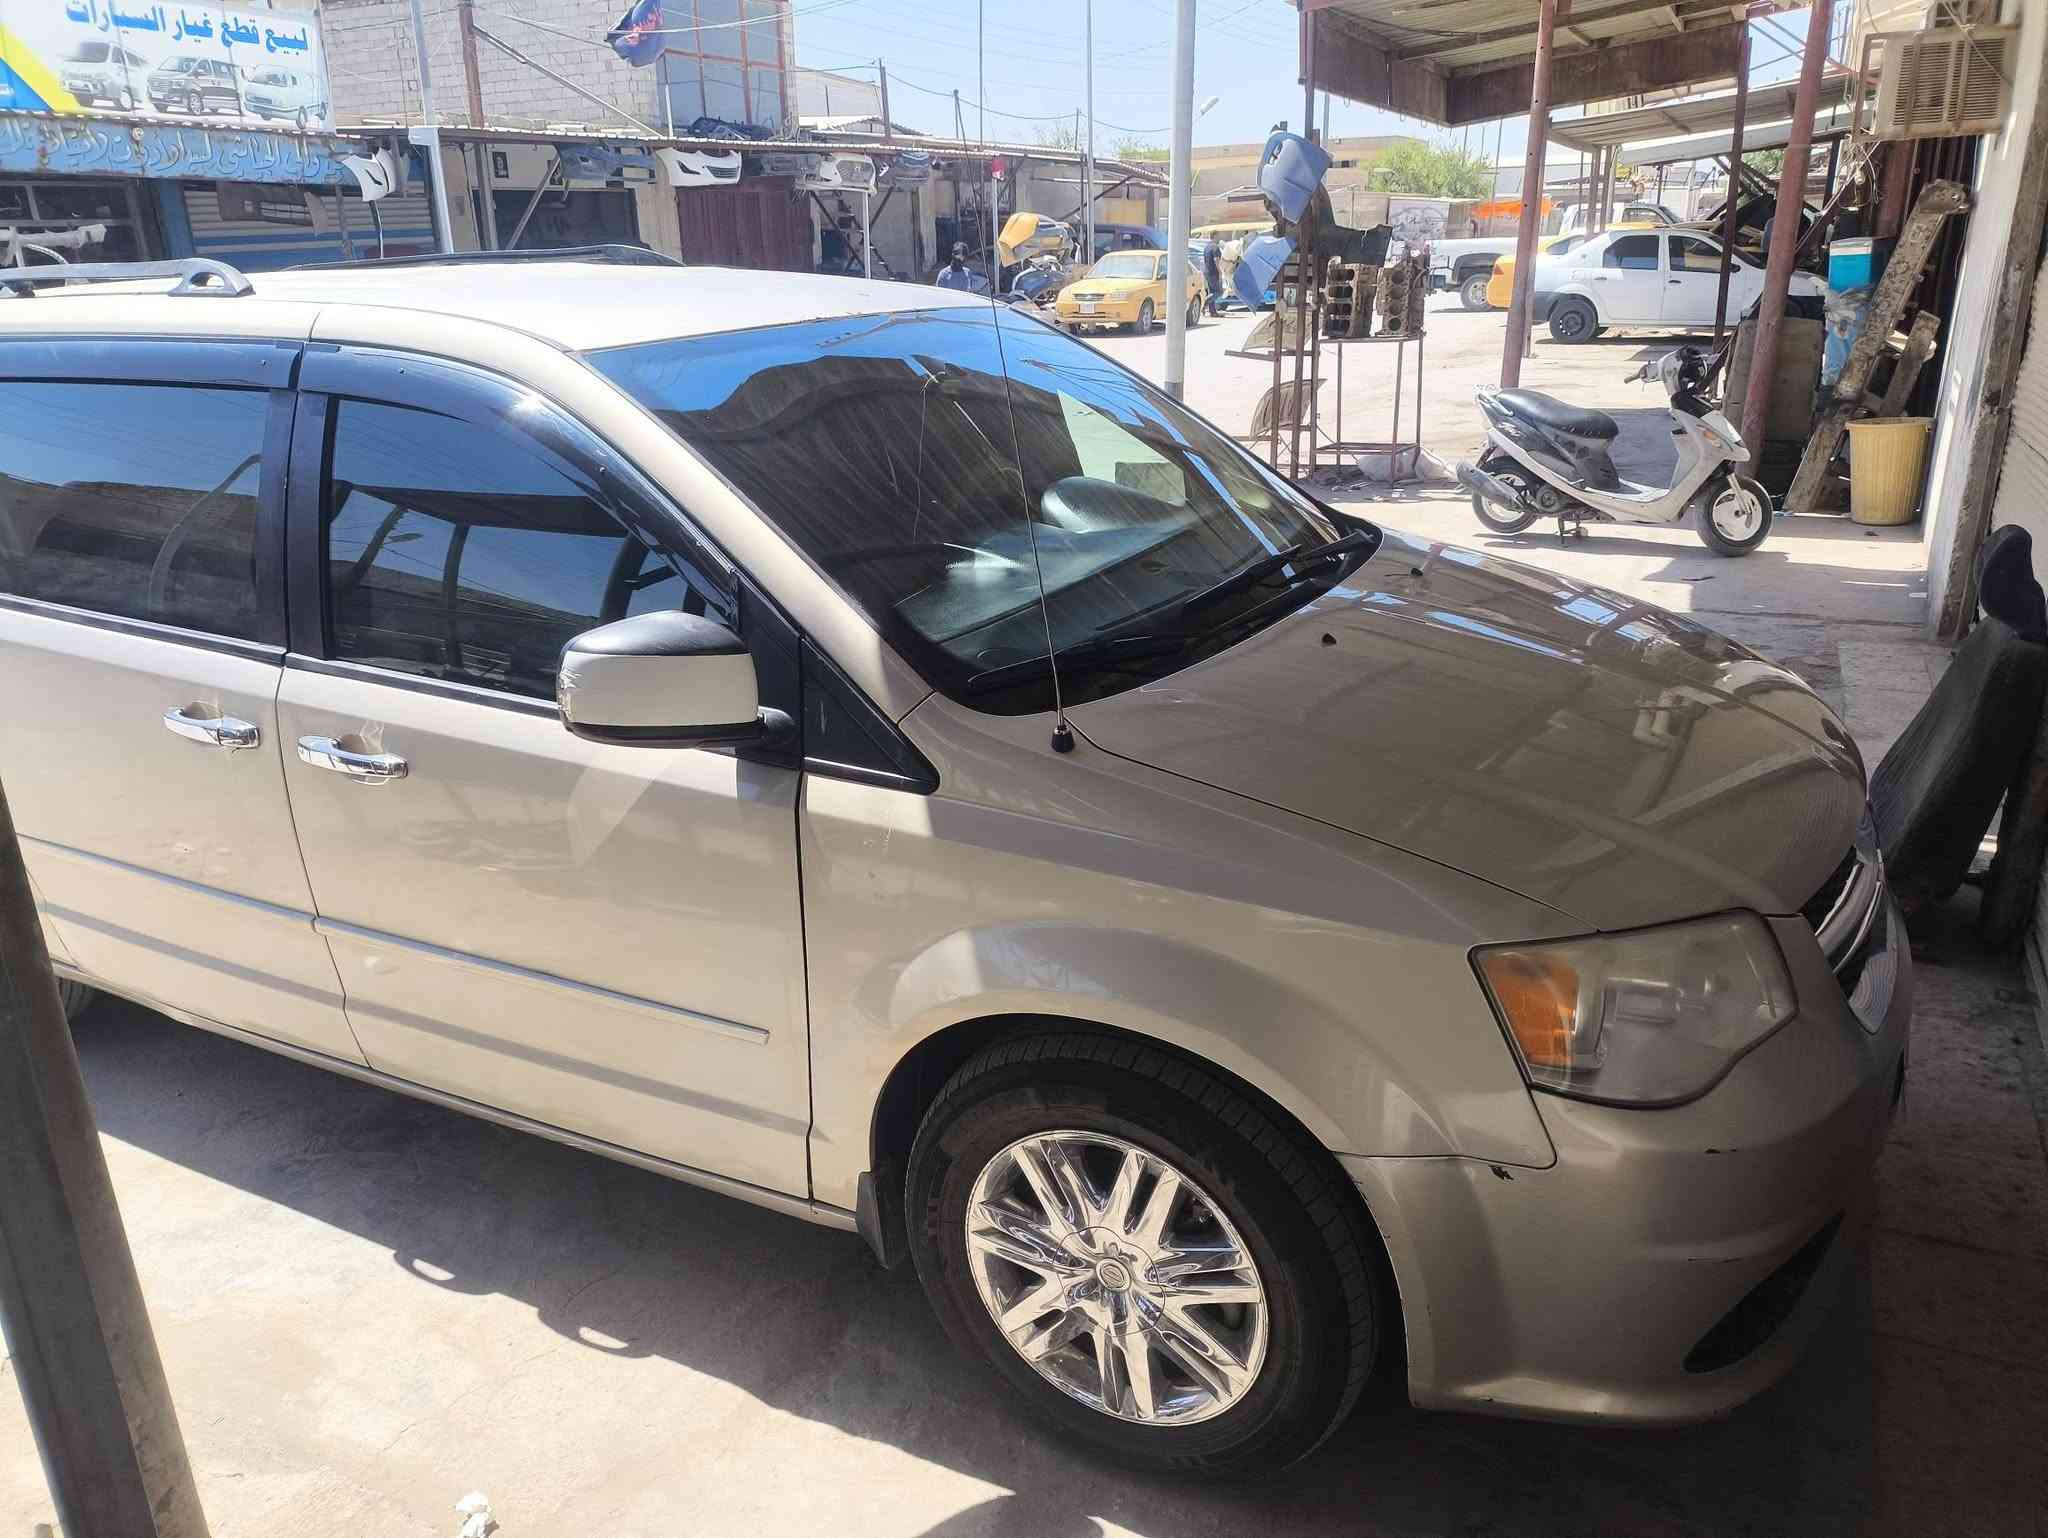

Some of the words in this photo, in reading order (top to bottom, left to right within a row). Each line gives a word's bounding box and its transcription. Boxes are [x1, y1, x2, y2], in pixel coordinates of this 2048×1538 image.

[66, 0, 167, 34] السيارات
[172, 9, 213, 43] غيار
[220, 16, 261, 48] قطع
[265, 27, 309, 55] لبيع
